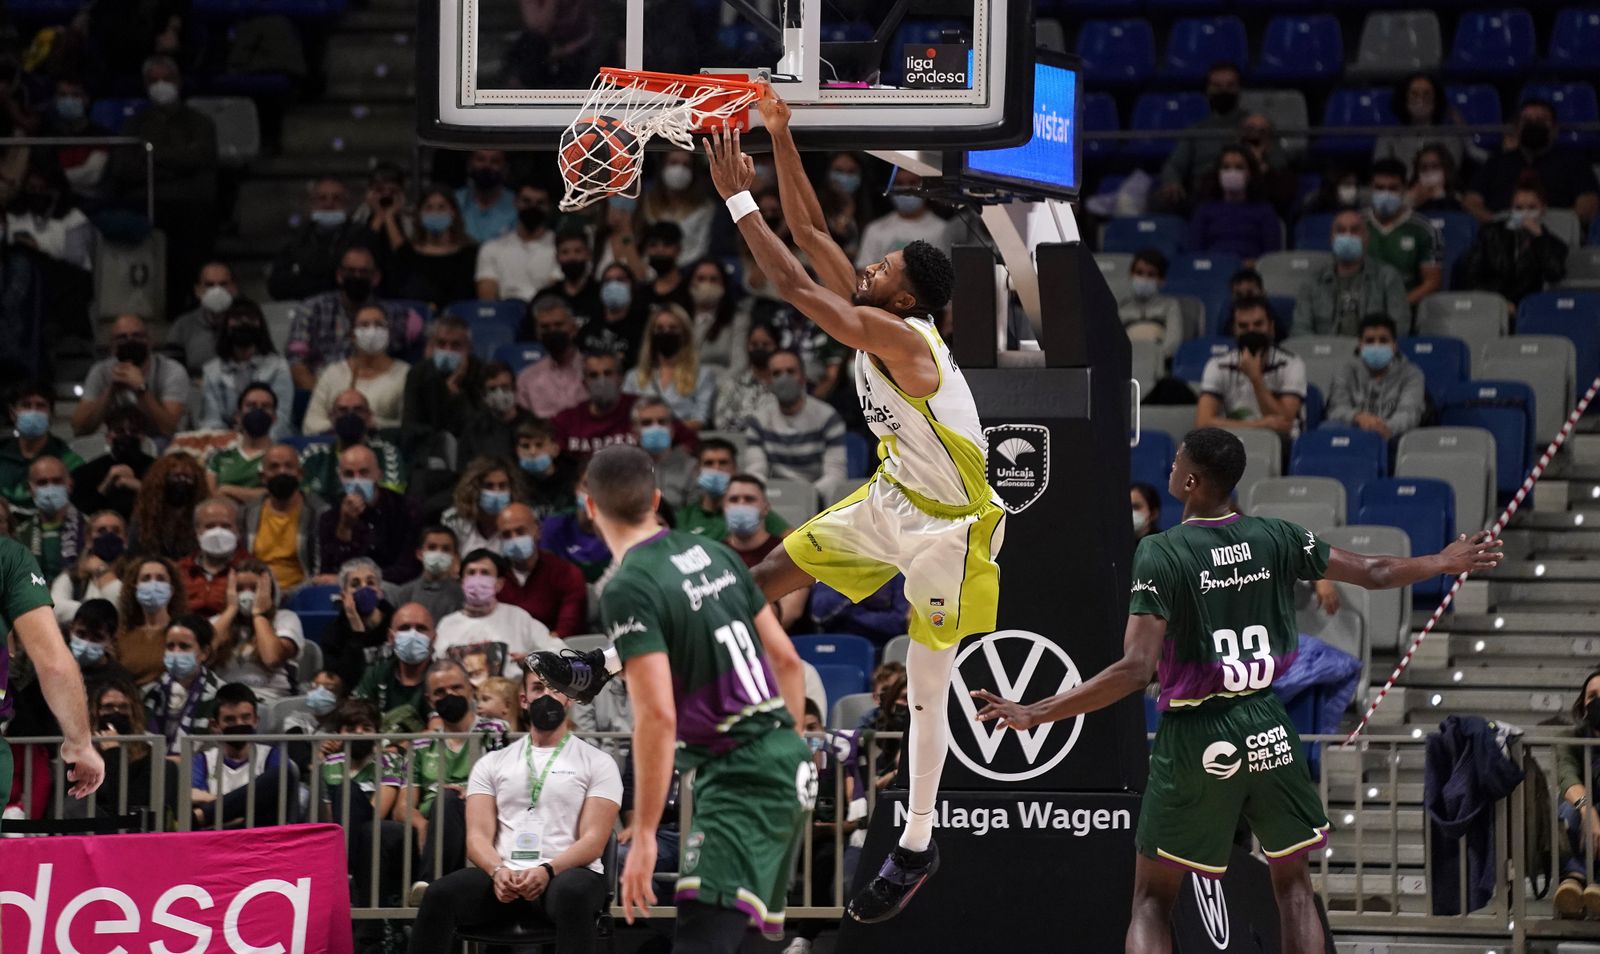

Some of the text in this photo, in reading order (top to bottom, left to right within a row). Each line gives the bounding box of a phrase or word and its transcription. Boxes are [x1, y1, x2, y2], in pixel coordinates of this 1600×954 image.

[906, 56, 933, 71] liga
[906, 70, 965, 83] endesa
[1033, 104, 1070, 144] vistar
[996, 466, 1034, 479] Unicaja
[1210, 542, 1252, 567] NZOSA
[1212, 624, 1276, 692] 33
[1245, 725, 1288, 749] COSTA
[1248, 743, 1292, 763] DEL SOL
[1017, 801, 1131, 837] Wagen
